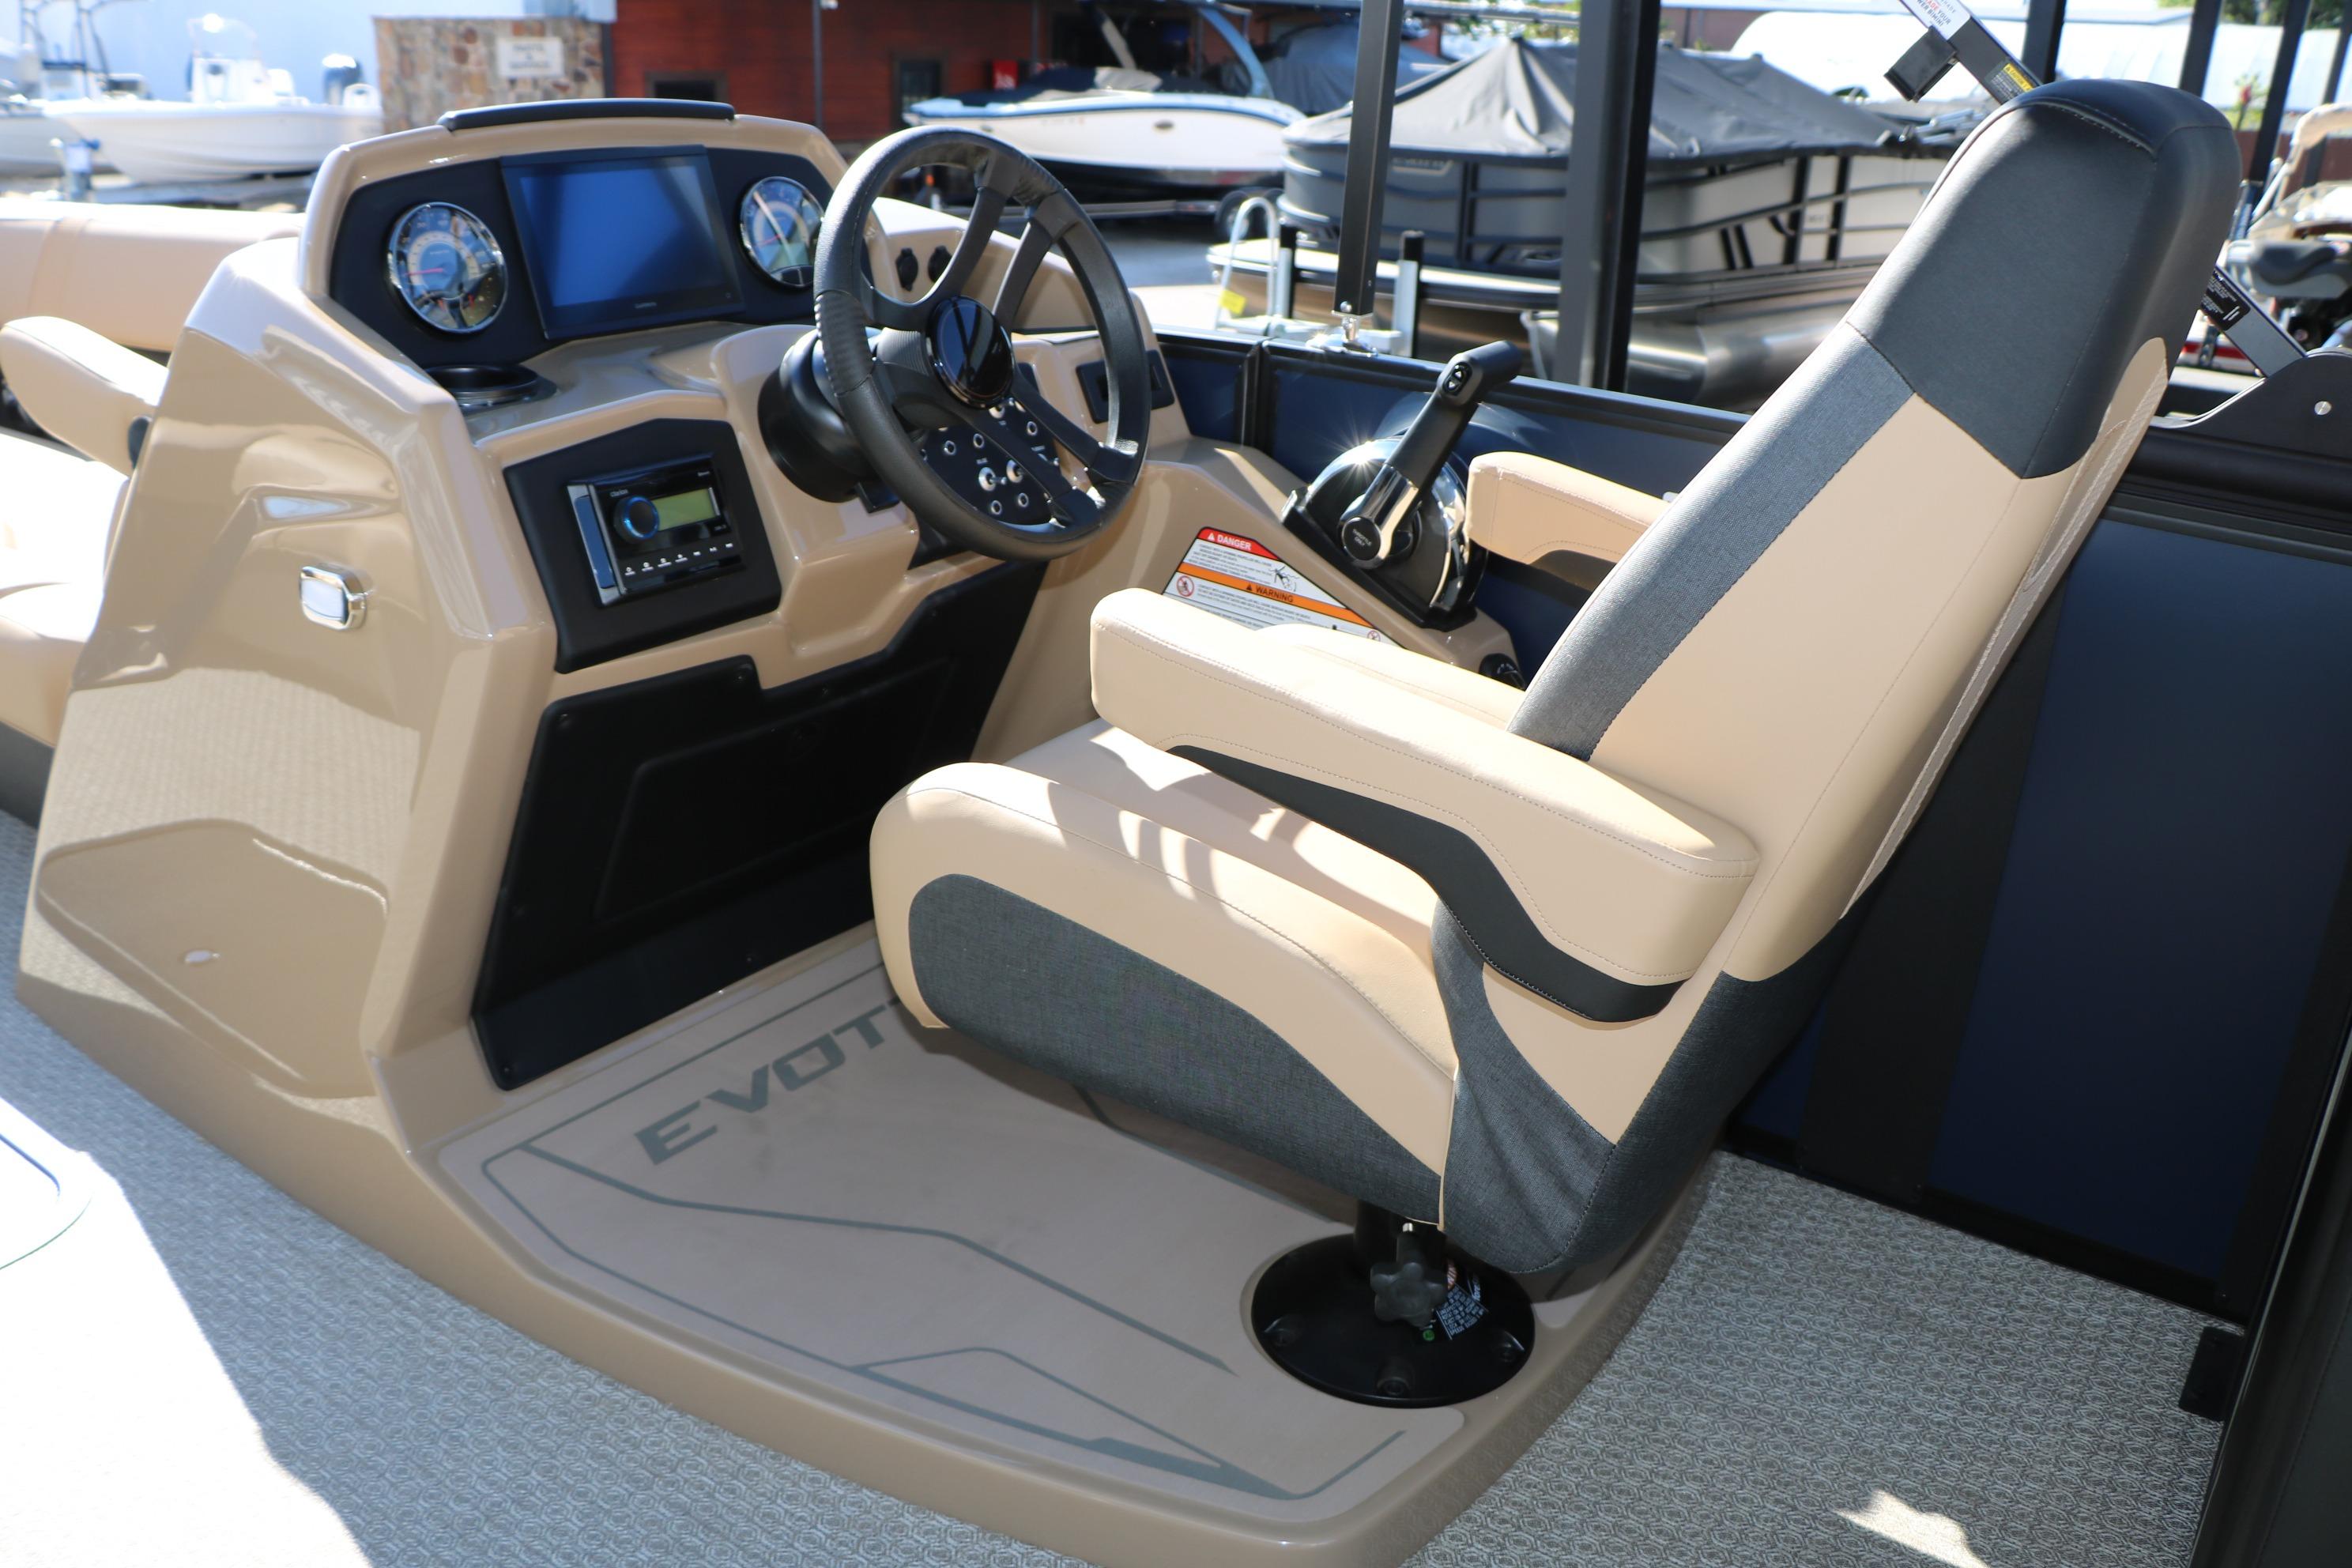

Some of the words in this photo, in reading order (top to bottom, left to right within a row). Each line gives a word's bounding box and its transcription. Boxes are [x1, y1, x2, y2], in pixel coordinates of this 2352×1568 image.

[1217, 534, 1252, 552] DANGER
[1255, 585, 1295, 603] WARNING
[634, 997, 900, 1166] EVOT
